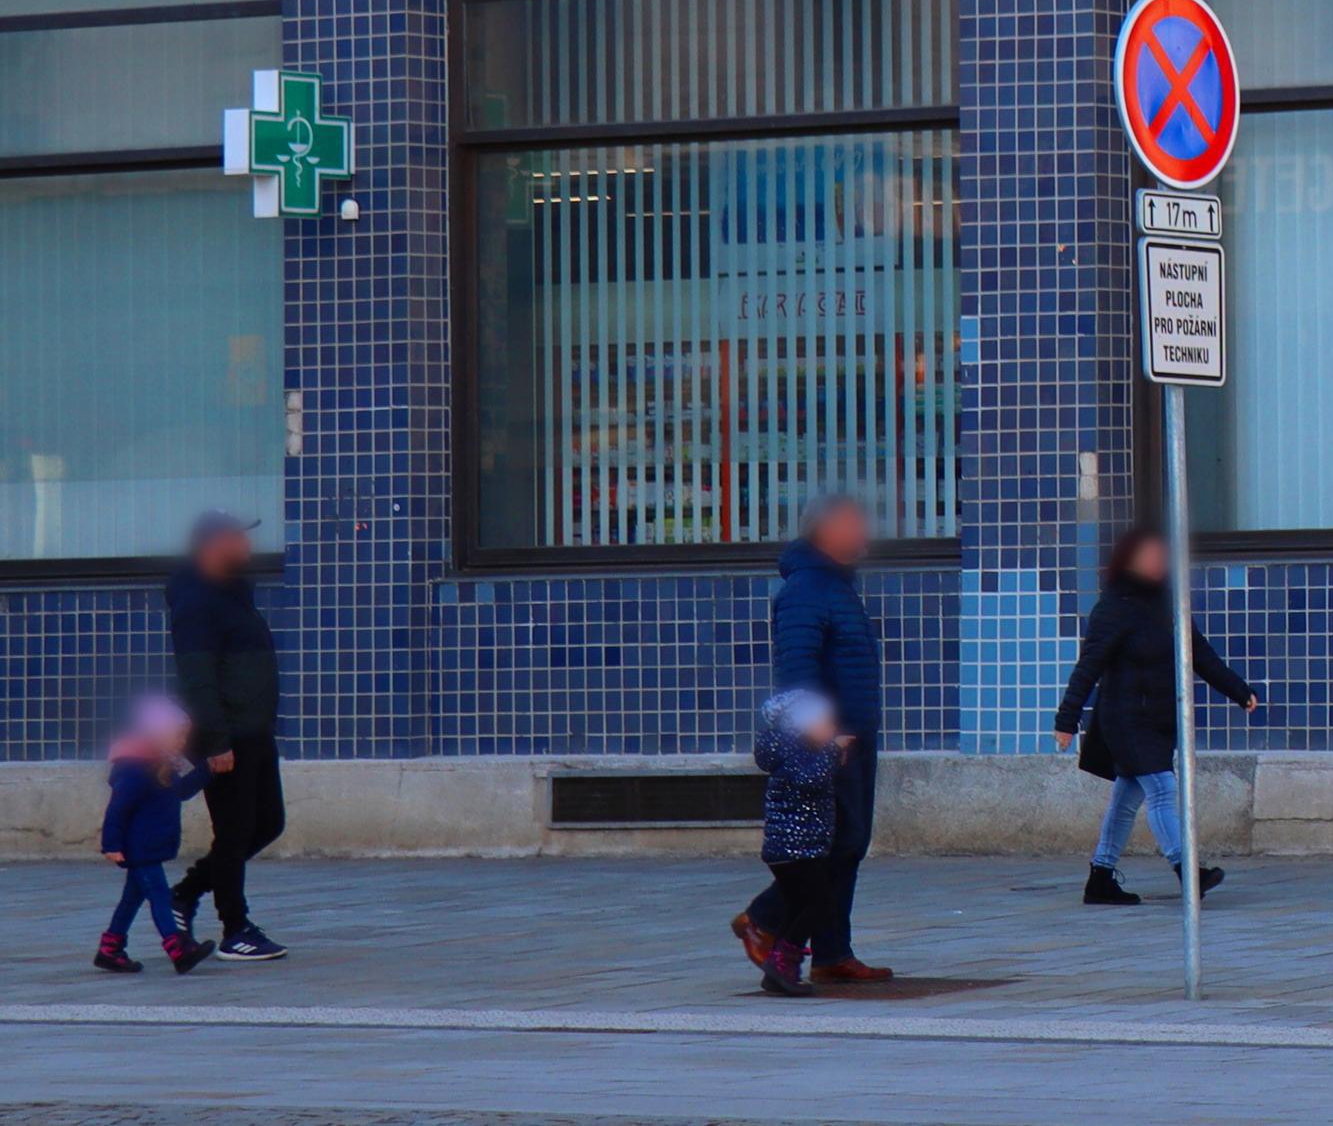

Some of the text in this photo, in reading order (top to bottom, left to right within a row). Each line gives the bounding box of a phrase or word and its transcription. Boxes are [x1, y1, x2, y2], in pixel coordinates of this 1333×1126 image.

[1159, 257, 1208, 282] NÁSTUPNÍ
[1165, 290, 1203, 310] PLOCHA
[1154, 314, 1217, 338] PRO POŽÁRNÍ
[1163, 345, 1210, 365] TECHNIKU
